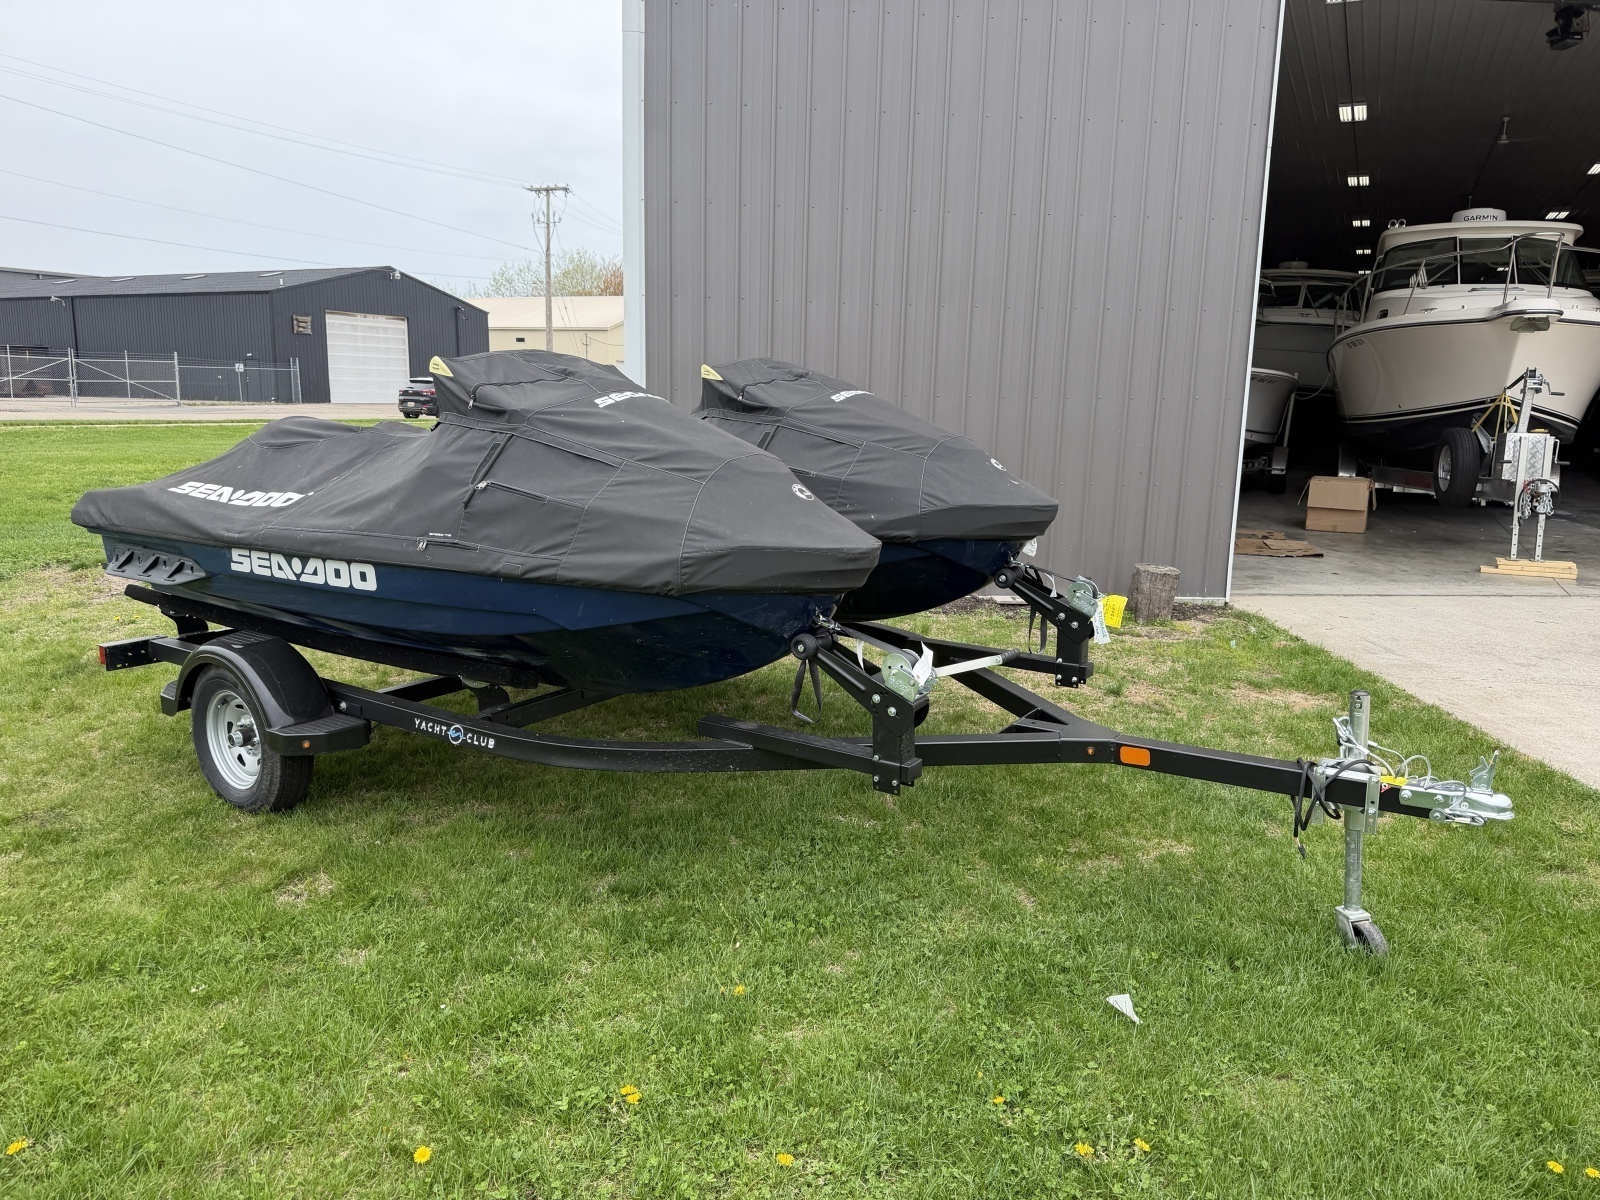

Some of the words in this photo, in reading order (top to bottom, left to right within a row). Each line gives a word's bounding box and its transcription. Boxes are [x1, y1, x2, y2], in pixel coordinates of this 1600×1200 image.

[1463, 214, 1499, 222] GARMIN
[414, 717, 447, 736] YACHT
[466, 733, 495, 749] CLUB
